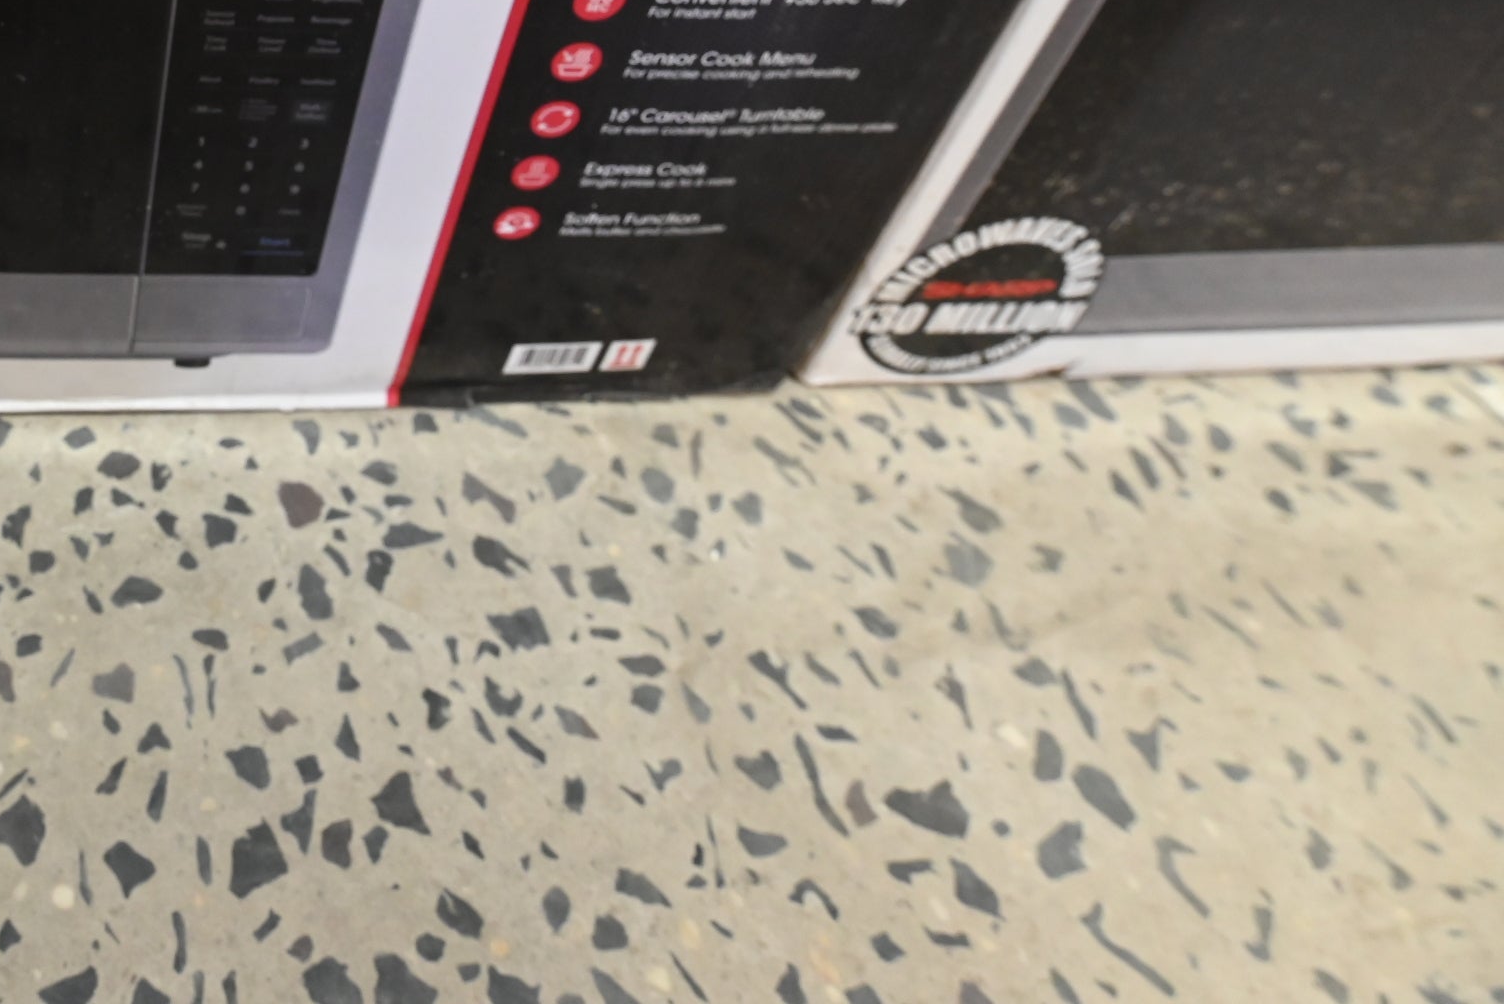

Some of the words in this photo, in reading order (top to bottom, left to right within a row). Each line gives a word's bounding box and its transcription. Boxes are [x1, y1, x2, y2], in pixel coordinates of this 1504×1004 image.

[627, 49, 698, 67] Sensor
[700, 49, 754, 67] Cook
[758, 50, 817, 67] Menu
[582, 161, 654, 178] Express
[655, 161, 708, 177] Cook
